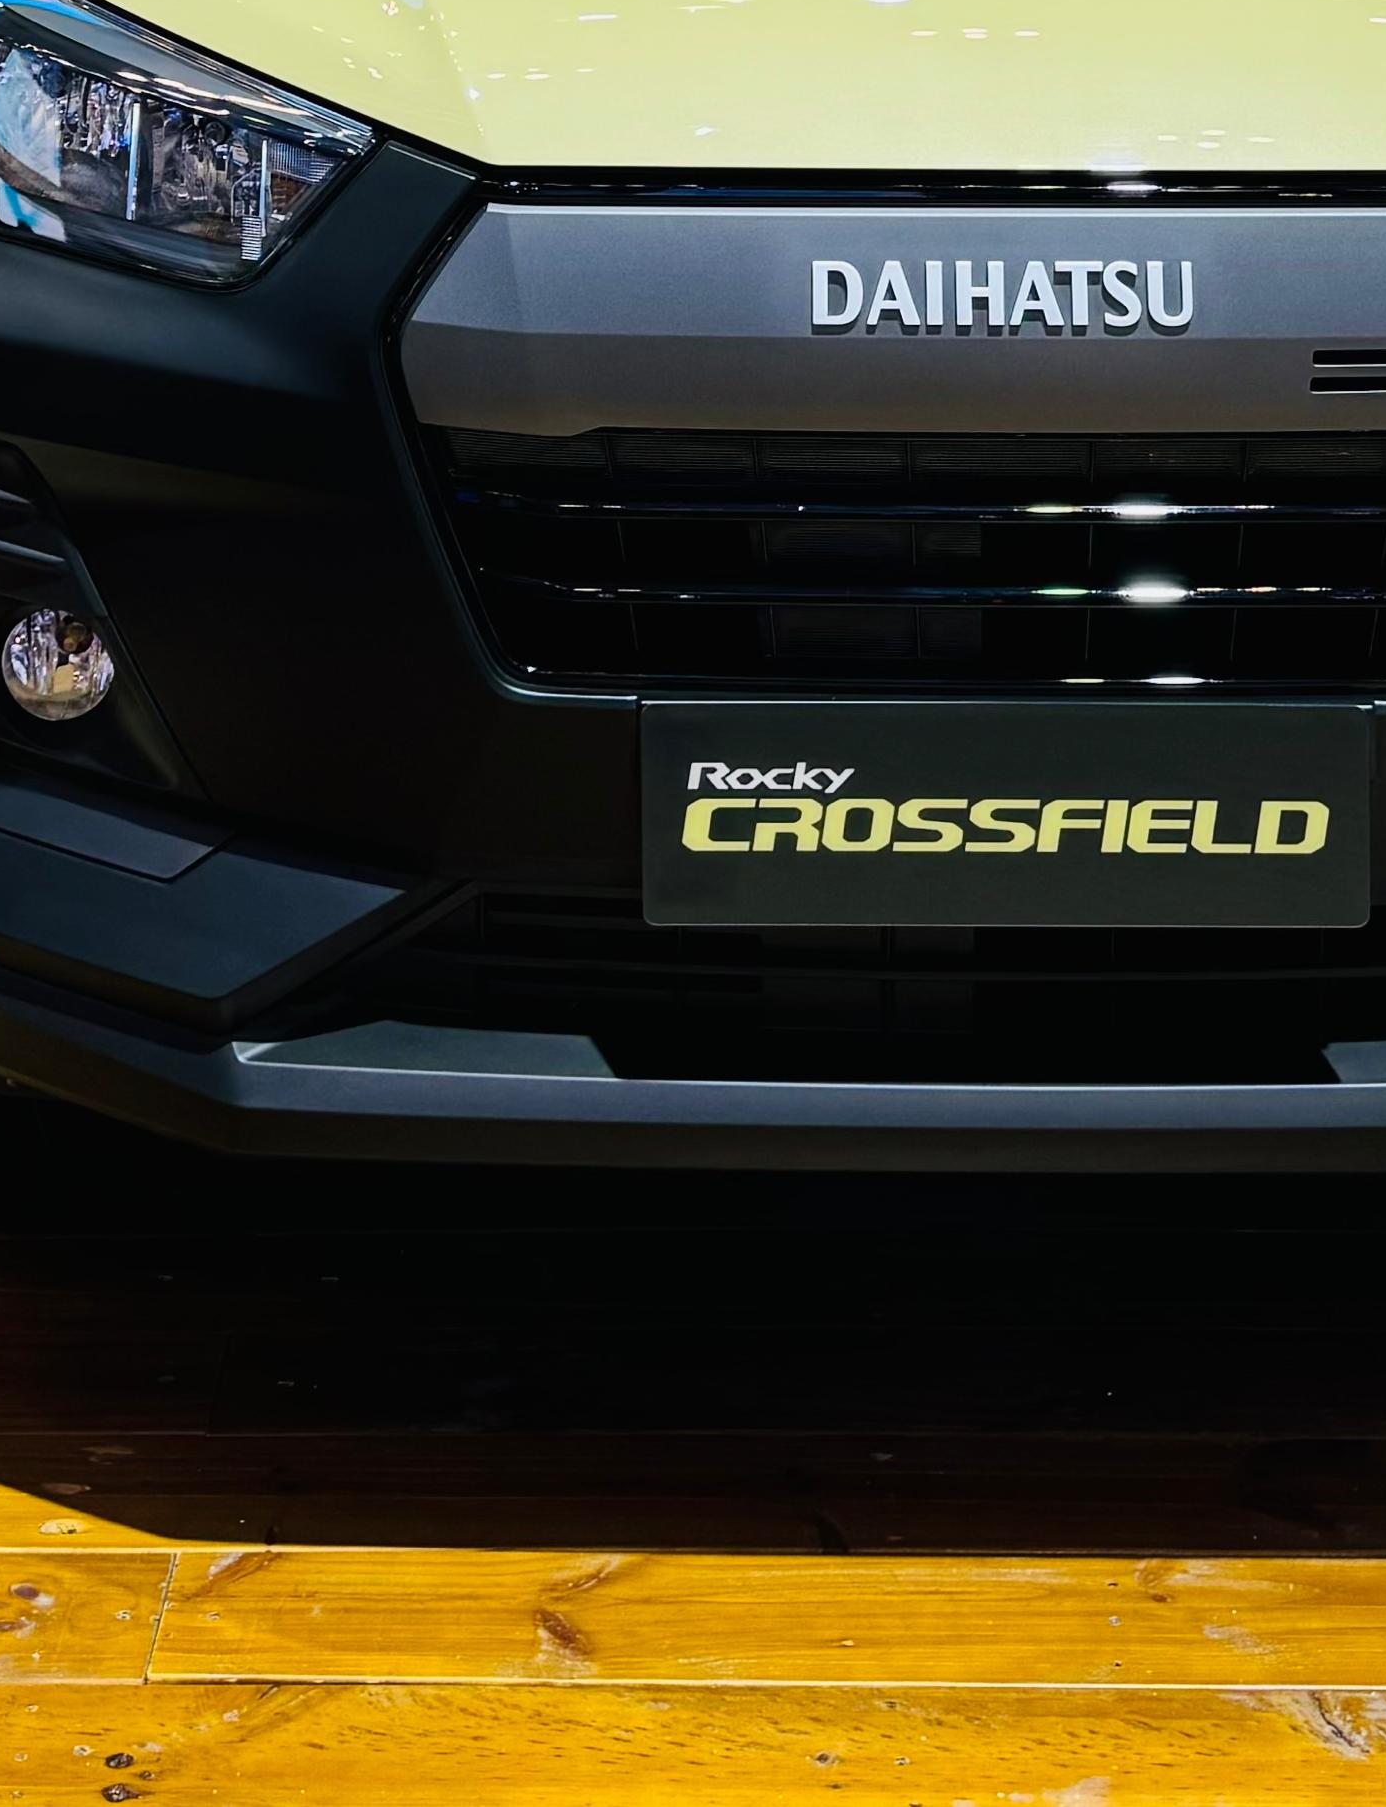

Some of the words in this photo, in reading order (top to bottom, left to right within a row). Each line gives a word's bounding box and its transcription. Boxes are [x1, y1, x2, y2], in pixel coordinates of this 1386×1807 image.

[811, 260, 1195, 328] DAIHATSU
[687, 762, 855, 793] Rocky
[681, 798, 1330, 854] CROSSFIELD
